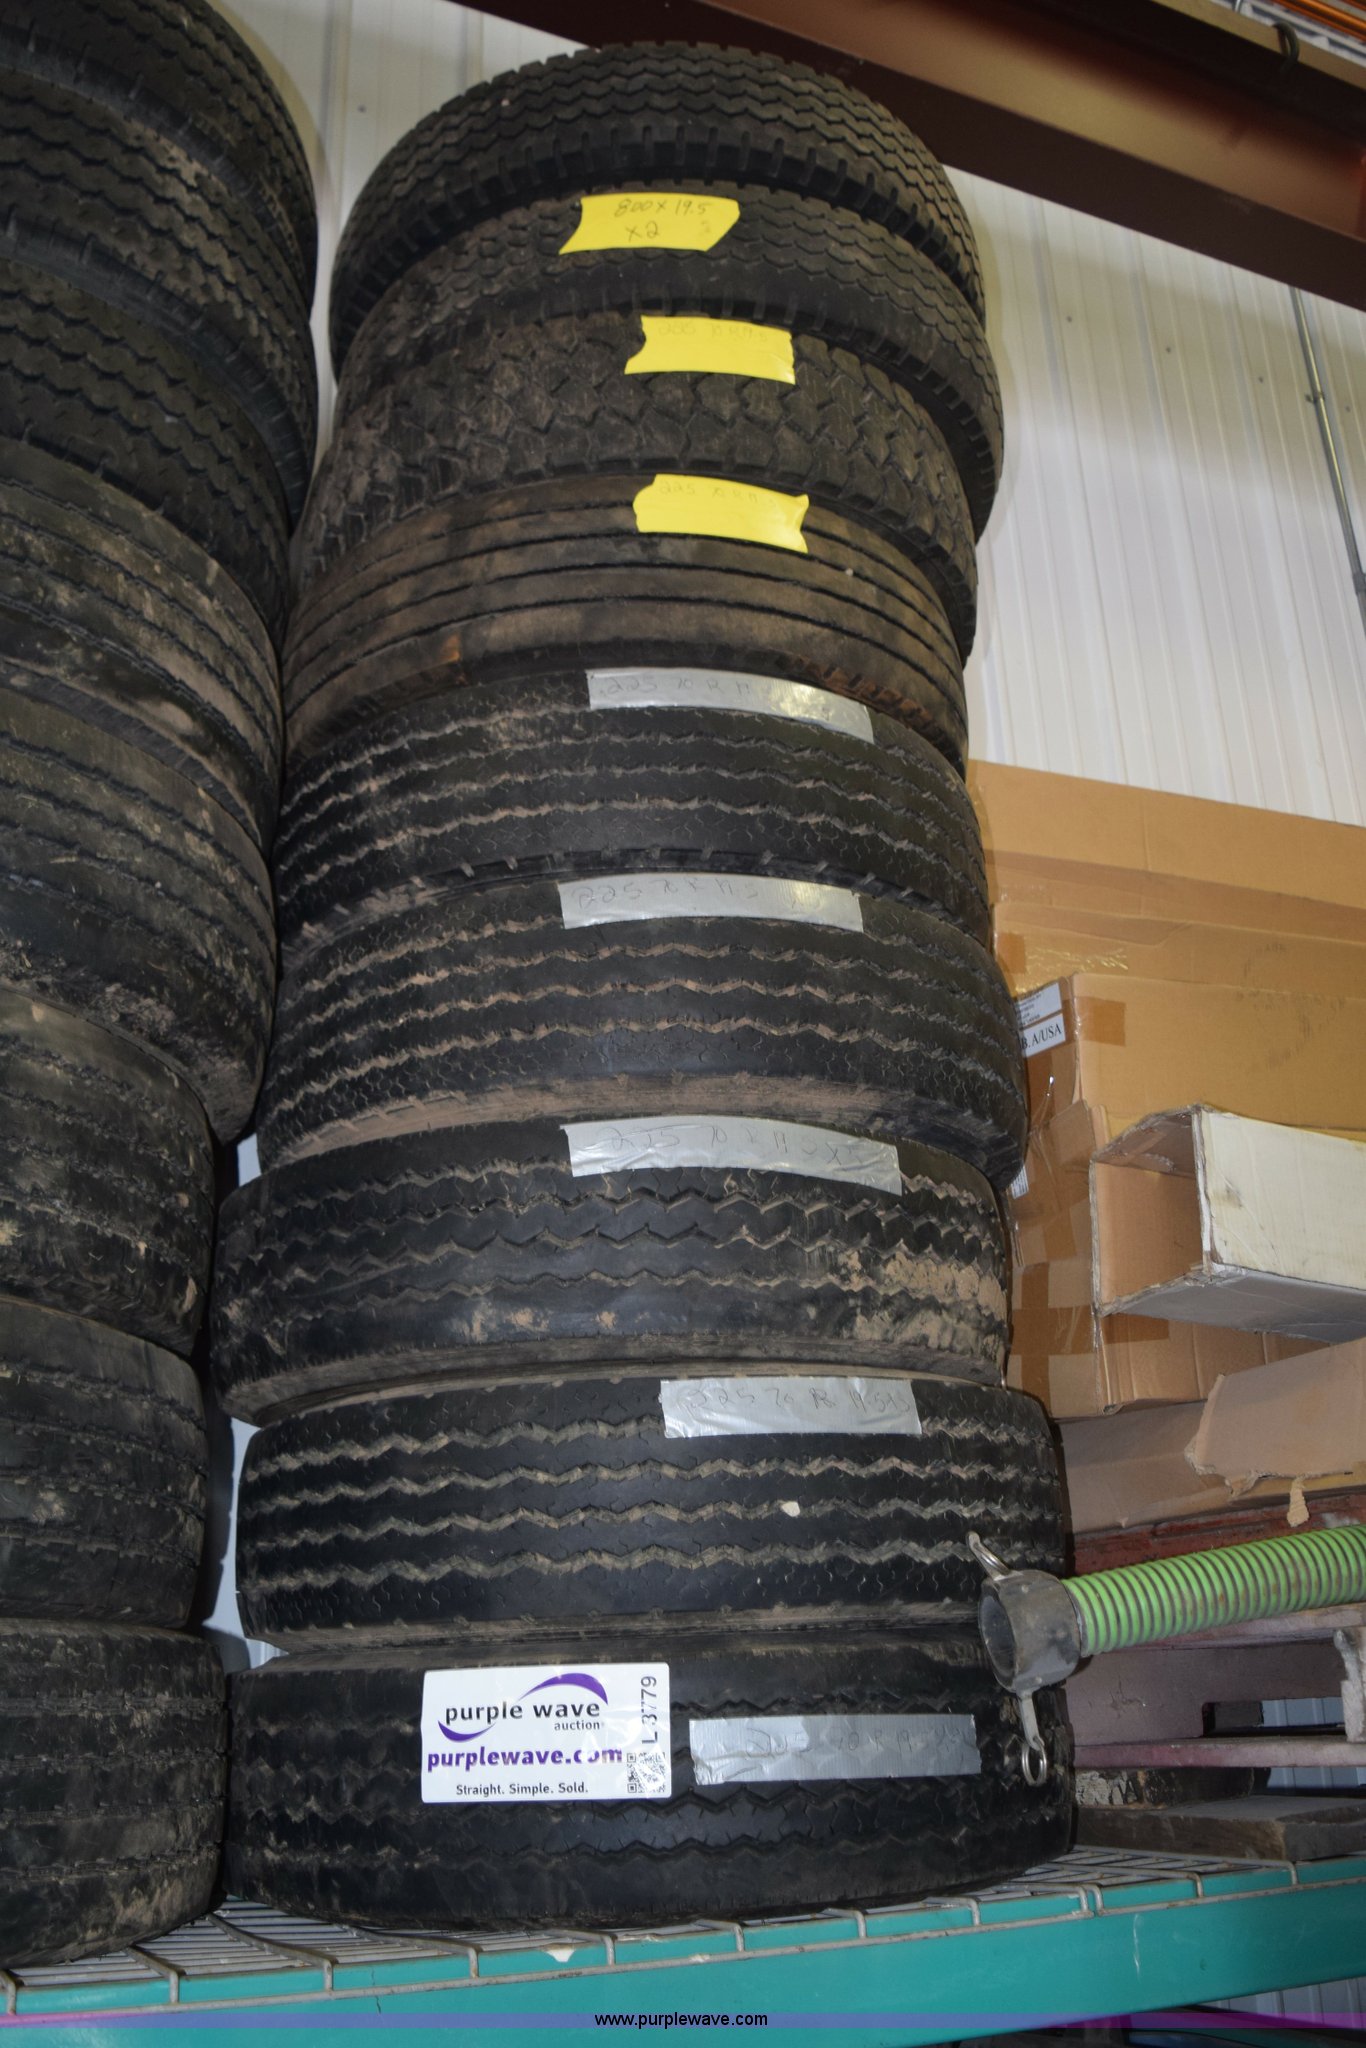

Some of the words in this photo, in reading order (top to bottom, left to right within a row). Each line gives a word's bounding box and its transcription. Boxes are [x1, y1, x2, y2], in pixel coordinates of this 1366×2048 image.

[445, 1700, 524, 1724] purple
[534, 1703, 601, 1718] wave
[553, 1719, 601, 1731] auction
[427, 1745, 623, 1773] purplewave.com
[456, 1781, 505, 1796] Straight.
[509, 1781, 555, 1797] Simple.
[558, 1780, 589, 1794] Sold.
